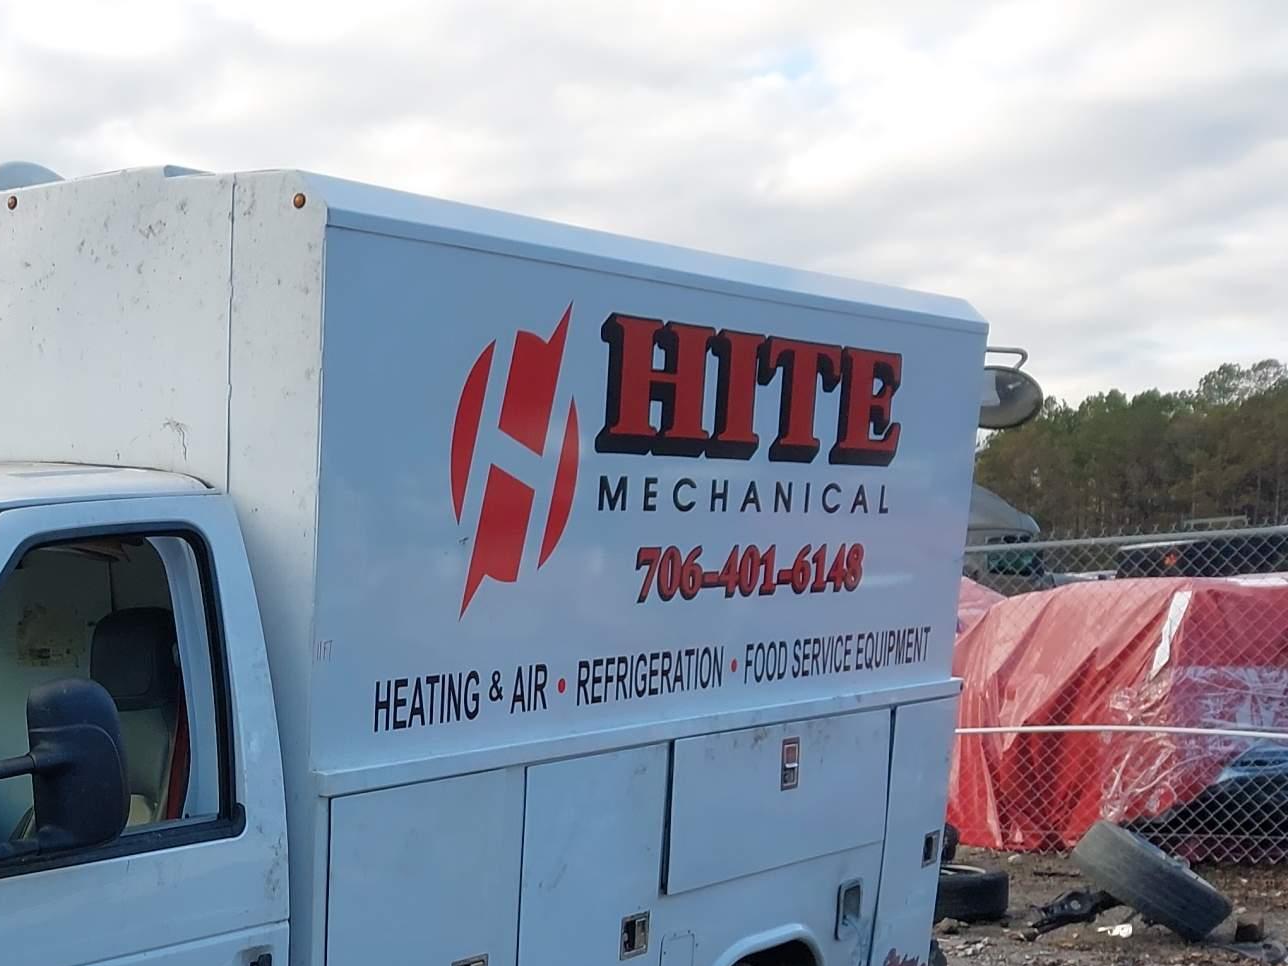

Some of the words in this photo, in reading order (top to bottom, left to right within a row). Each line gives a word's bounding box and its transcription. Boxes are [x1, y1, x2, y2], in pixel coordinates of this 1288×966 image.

[595, 312, 902, 467] HITE
[598, 475, 889, 514] MECHANICAL
[635, 543, 865, 604] 706-401-6148
[373, 670, 480, 732] HEATING
[488, 670, 504, 702] &
[509, 663, 548, 714] AIR
[576, 645, 725, 706] REFRIGERATION
[743, 640, 789, 684] FOOD
[791, 634, 854, 678] SERVICE
[855, 626, 932, 670] EQUIPMENT
